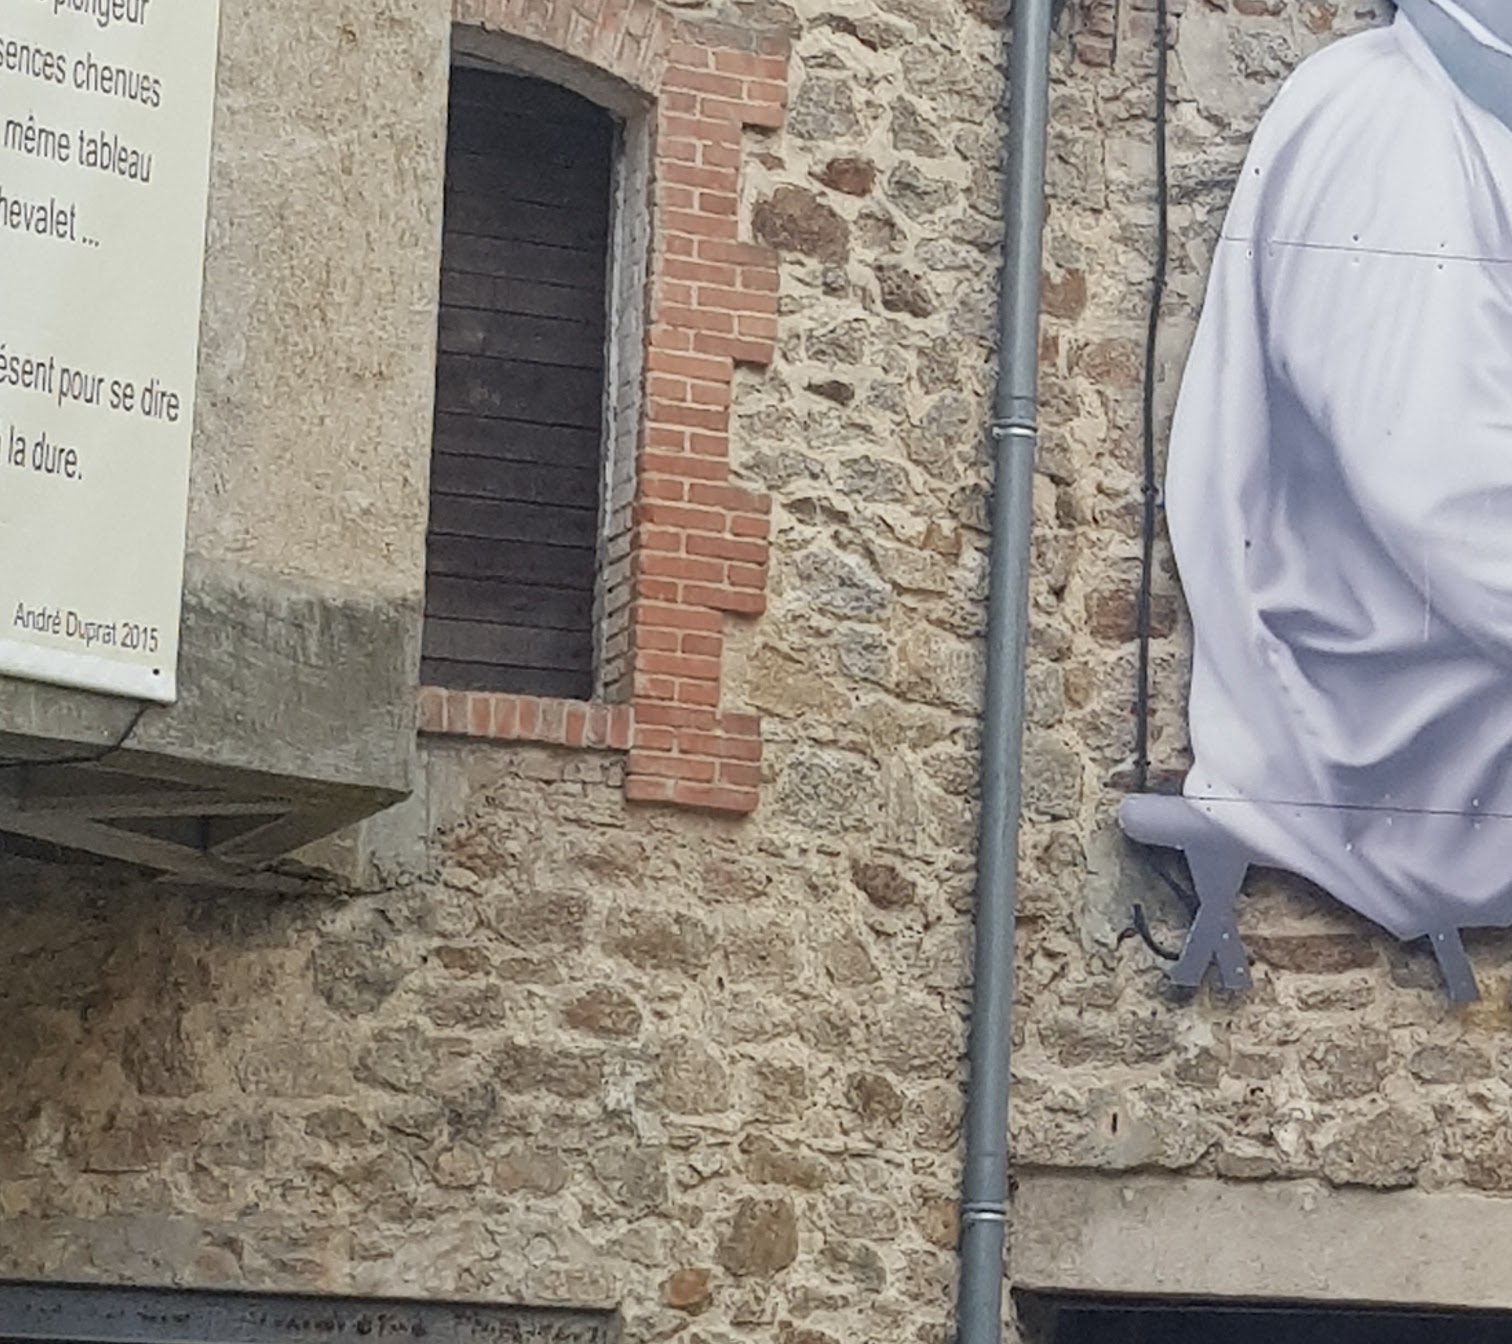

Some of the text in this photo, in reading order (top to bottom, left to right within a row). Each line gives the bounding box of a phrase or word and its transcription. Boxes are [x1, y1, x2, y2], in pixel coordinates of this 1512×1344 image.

[73, 52, 162, 107] chenues
[4, 114, 152, 182] même tableau
[58, 367, 104, 407] pour
[110, 380, 135, 412] se
[141, 378, 179, 421] dire
[8, 425, 26, 467] la
[32, 431, 82, 480] dure.
[14, 602, 158, 652] André Duprat 2015
